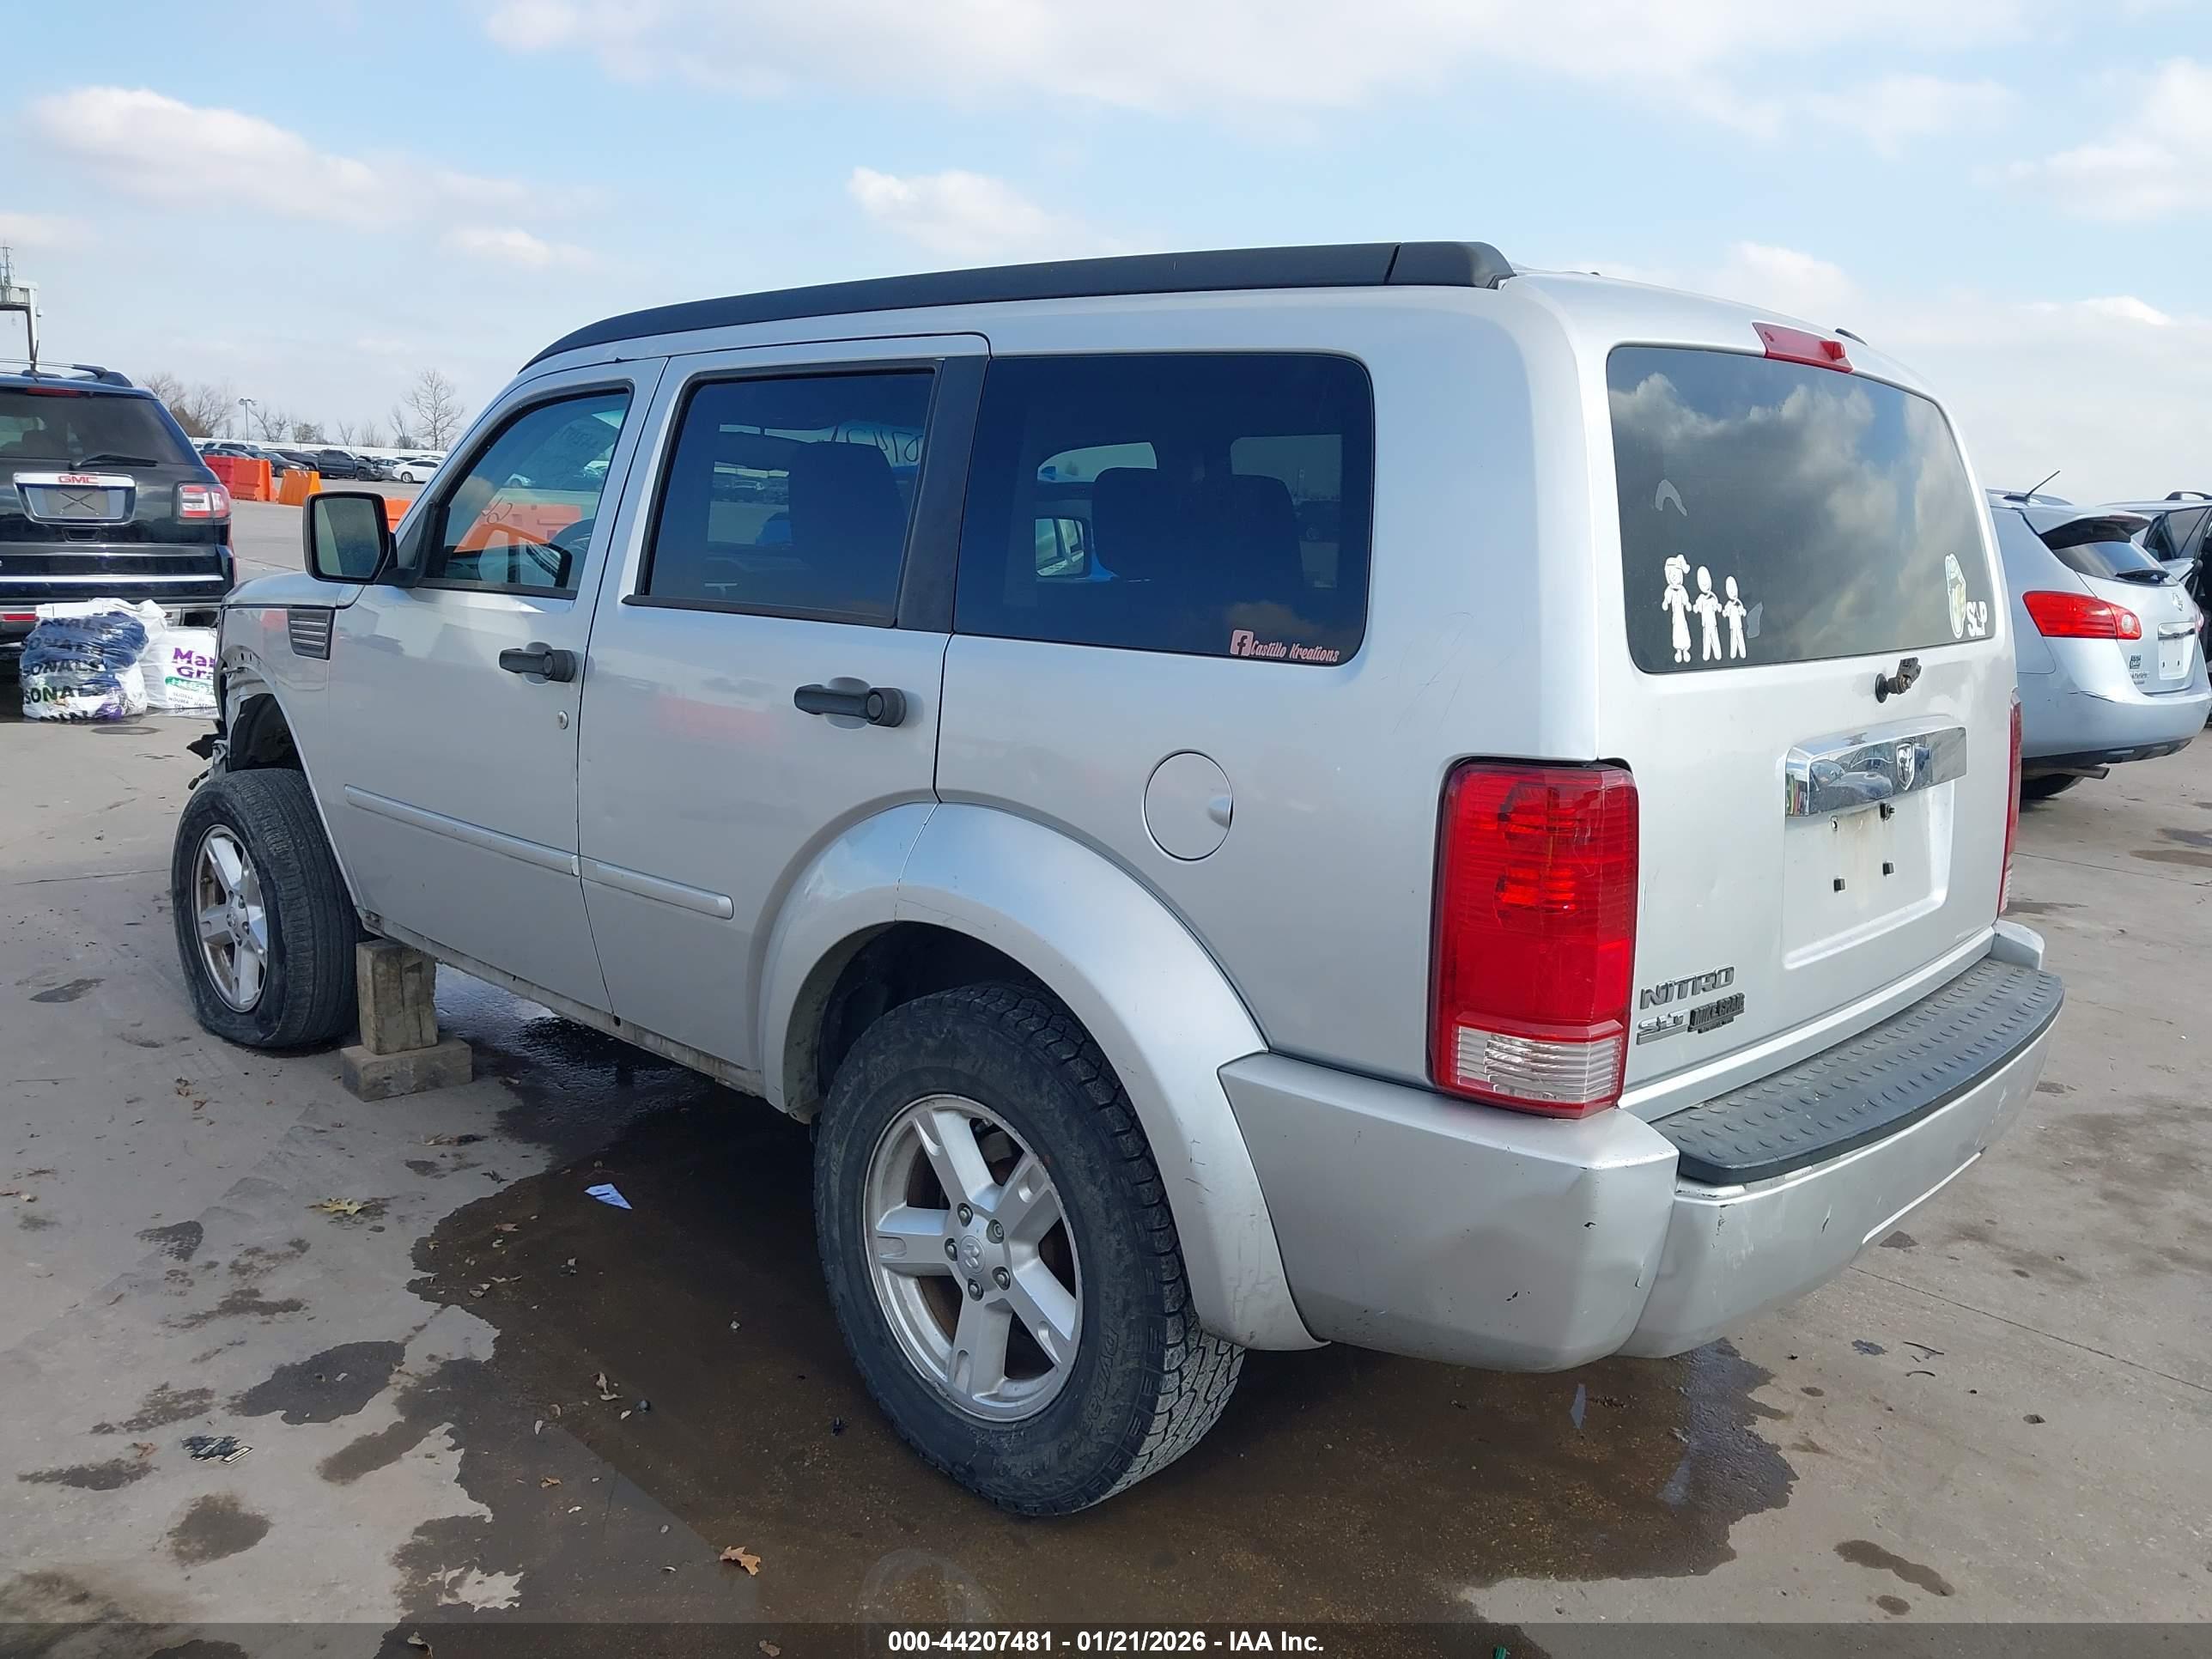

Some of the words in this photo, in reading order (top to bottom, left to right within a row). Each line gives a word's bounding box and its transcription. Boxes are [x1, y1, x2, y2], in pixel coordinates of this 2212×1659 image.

[1250, 640, 1287, 659] Castillo
[1289, 642, 1340, 663] Kreations
[1639, 966, 1735, 1010] NITRO
